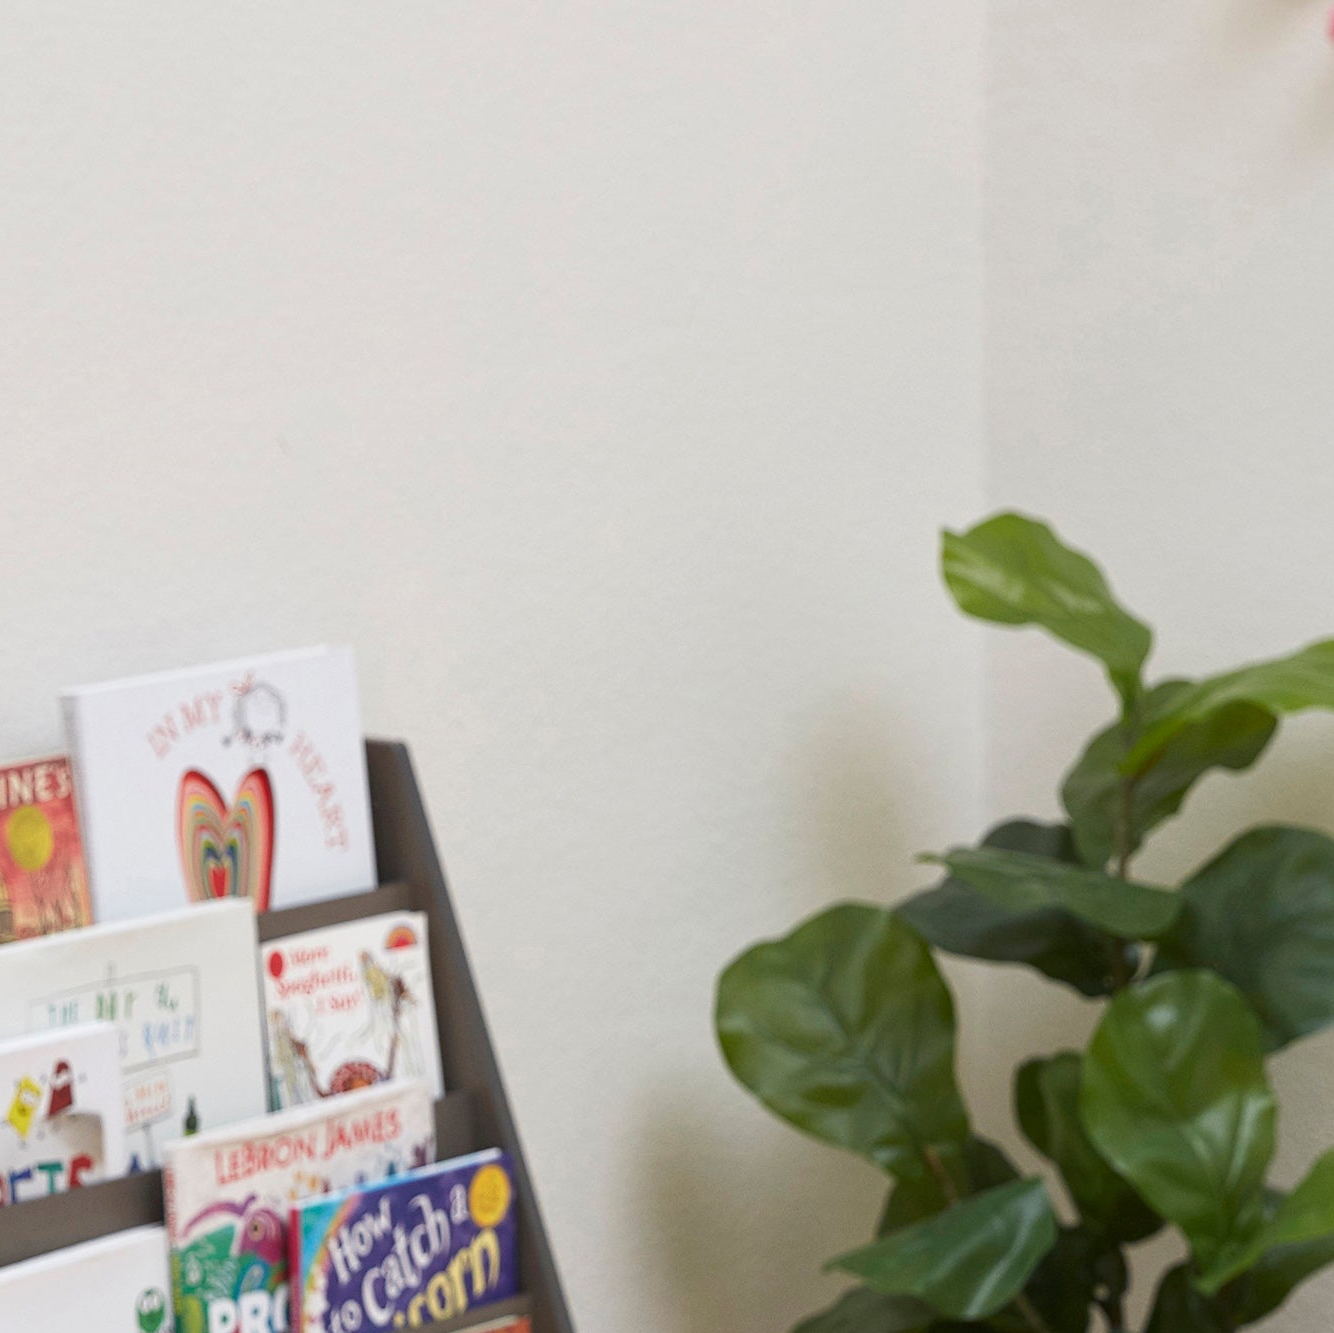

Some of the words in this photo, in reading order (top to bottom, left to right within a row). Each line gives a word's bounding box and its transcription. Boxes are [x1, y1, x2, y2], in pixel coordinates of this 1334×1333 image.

[179, 691, 222, 732] MY
[289, 730, 349, 852] HEART
[323, 1107, 401, 1160] JAMES
[328, 1196, 392, 1285] How
[362, 1194, 451, 1326] Catch
